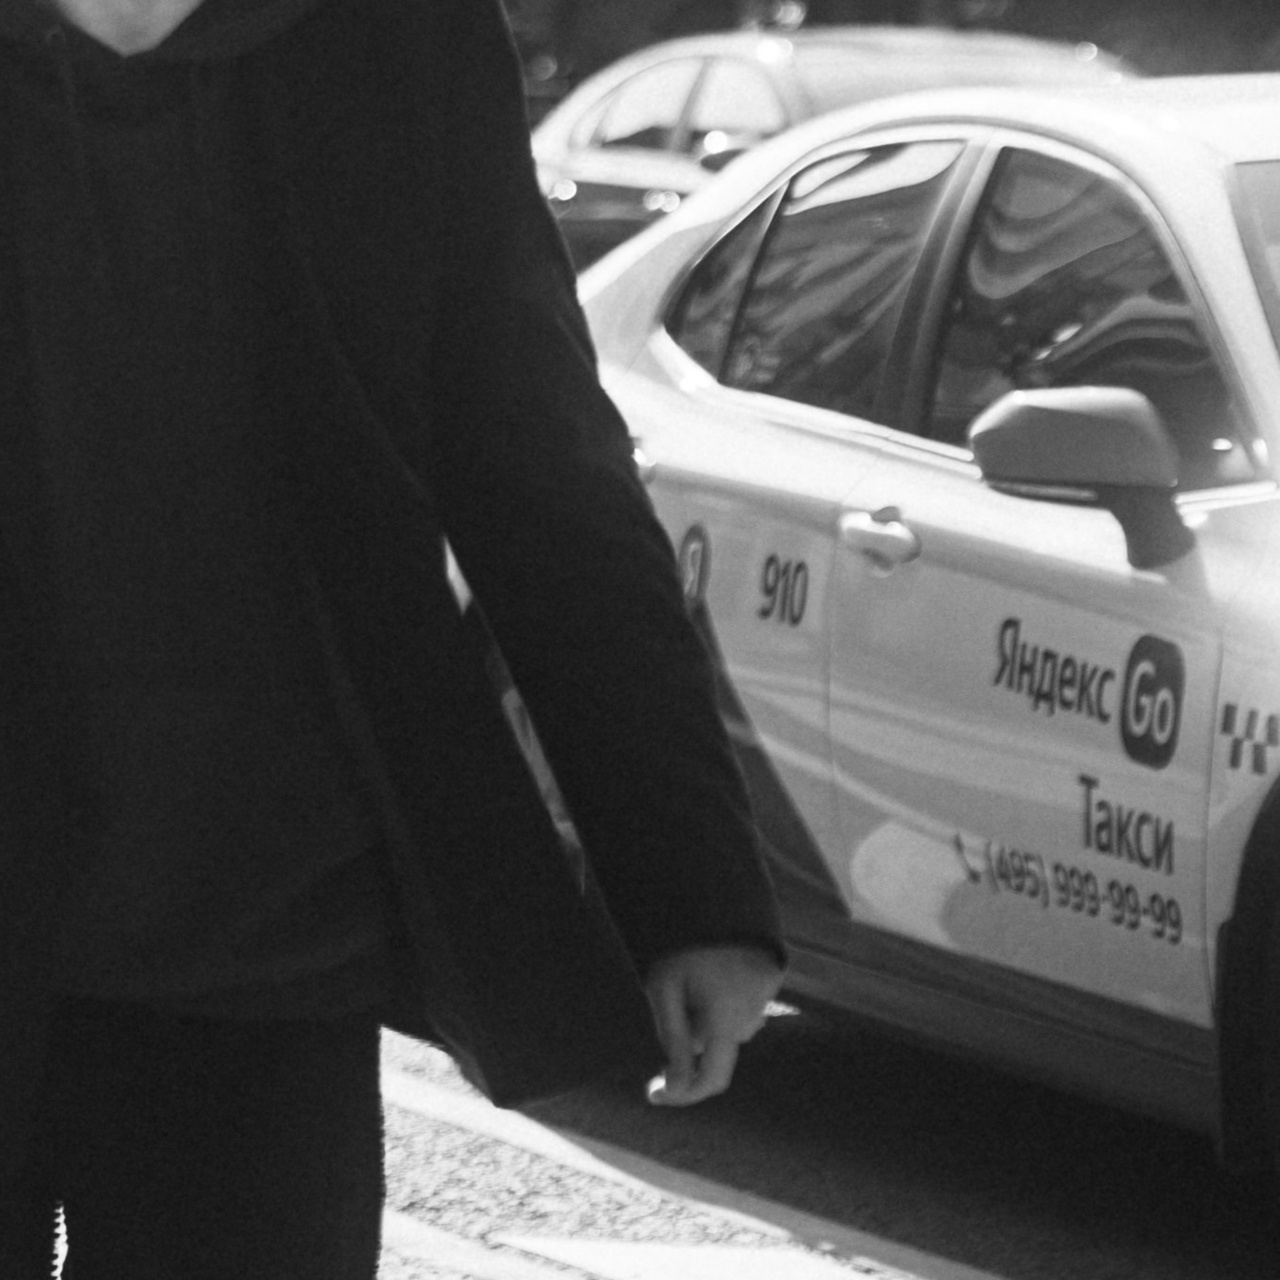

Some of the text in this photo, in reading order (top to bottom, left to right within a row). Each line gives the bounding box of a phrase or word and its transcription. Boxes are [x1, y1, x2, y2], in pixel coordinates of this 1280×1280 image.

[757, 551, 810, 628] 910
[992, 616, 1176, 747] Яндекс Go
[1077, 773, 1174, 874] Такси
[985, 840, 1183, 946] (495) 999-99-99
